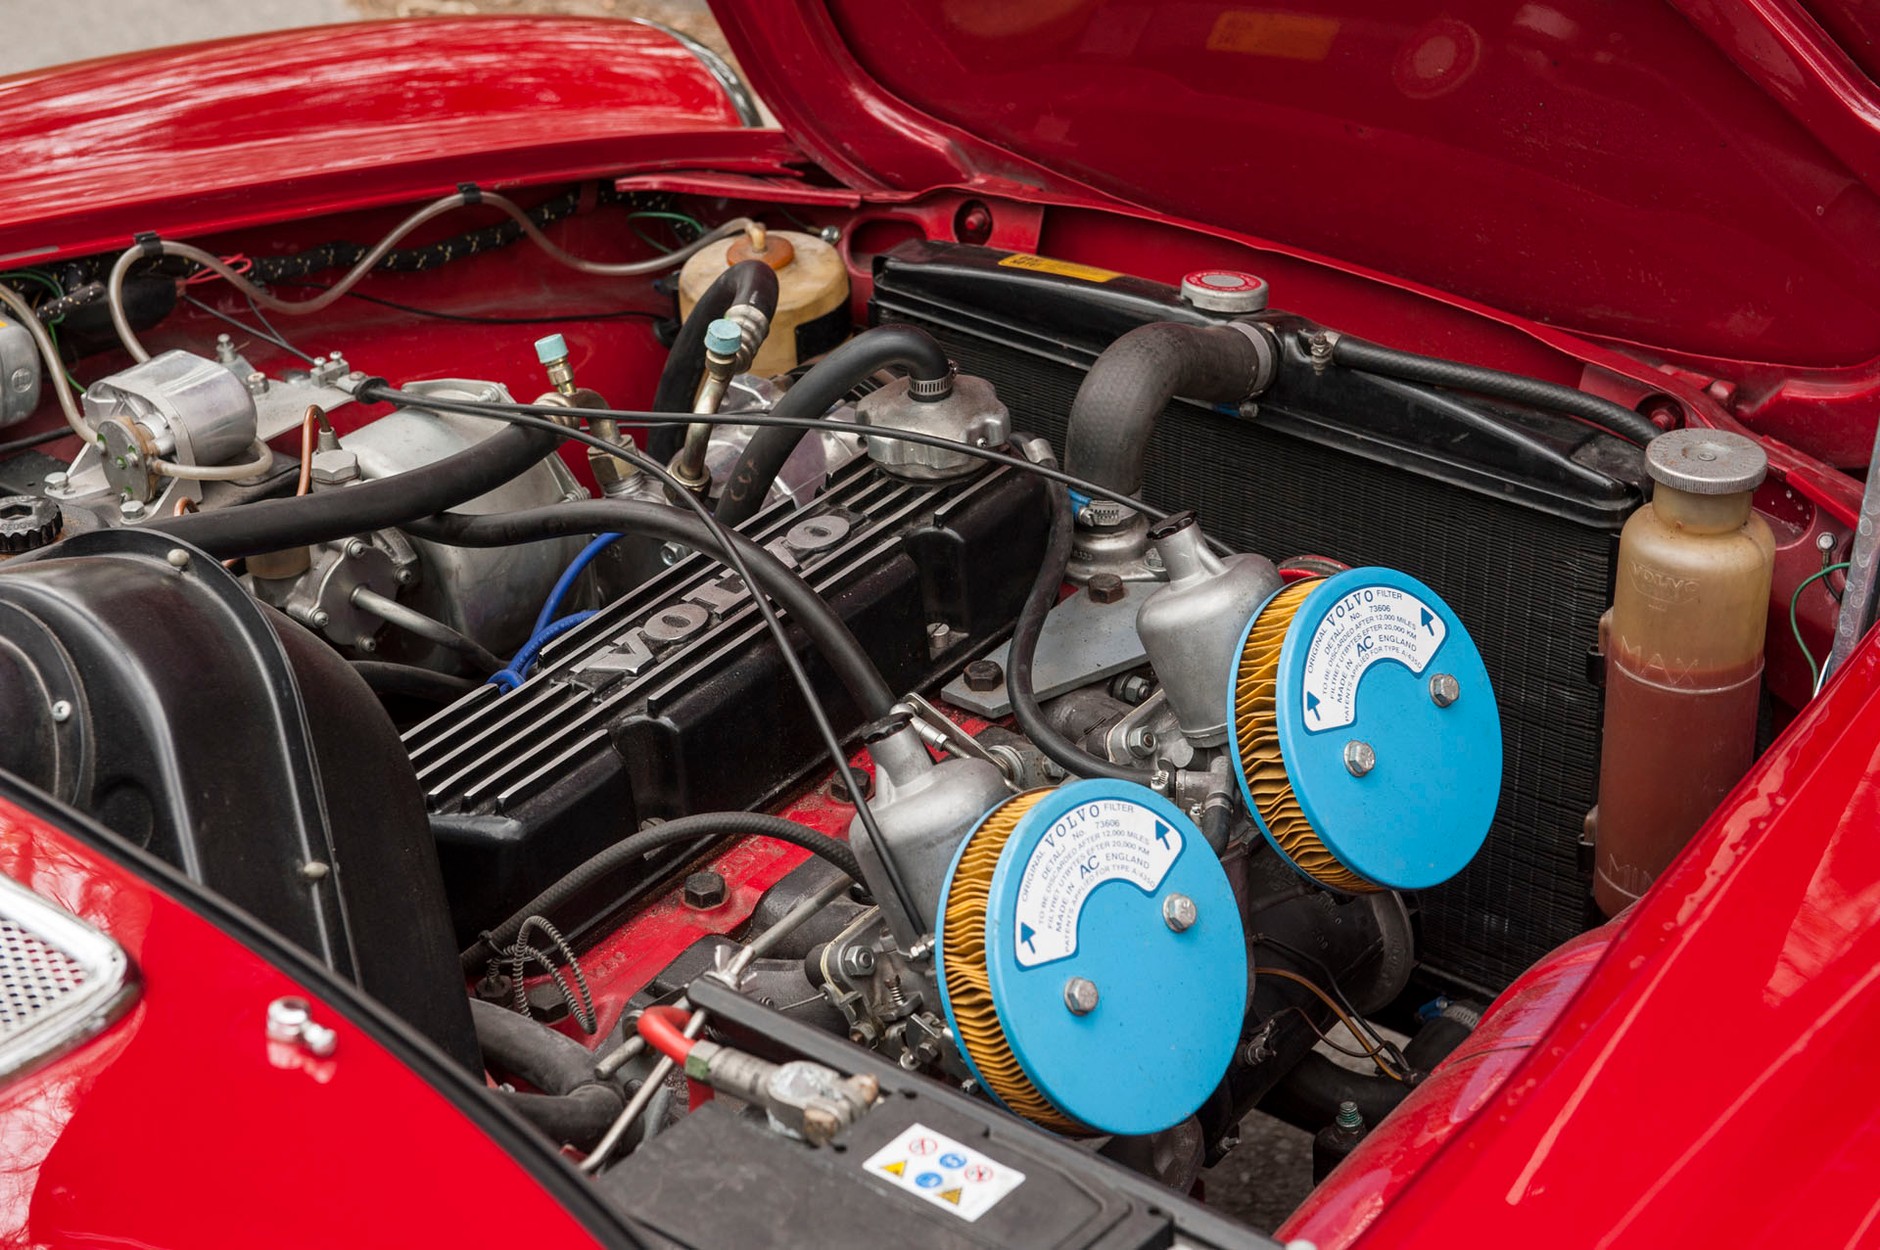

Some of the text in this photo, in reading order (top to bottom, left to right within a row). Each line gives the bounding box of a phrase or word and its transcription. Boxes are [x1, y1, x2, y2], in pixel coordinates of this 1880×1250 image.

[1631, 561, 1700, 592] VOLVO
[1307, 589, 1403, 674] ORIGINAL VOLVO FILTER
[1324, 623, 1345, 655] DETALJ
[1369, 604, 1391, 613] 73606
[1327, 627, 1355, 668] DISCARDED
[1355, 615, 1374, 630] AFTER
[1396, 616, 1416, 631] MILES
[1324, 668, 1331, 681] BE
[1330, 662, 1341, 700] FILTRET
[1338, 633, 1363, 663] UTBYTES
[1362, 624, 1383, 637] EFTER
[1406, 630, 1417, 640] KM
[1337, 634, 1417, 704] MADE IN AC ENGLAND
[1344, 681, 1353, 722] PATENTS
[1350, 653, 1370, 680] APPLIED
[1370, 645, 1383, 656] FOR
[1384, 645, 1400, 654] TYPE
[1621, 635, 1698, 685] MAX
[1322, 682, 1328, 695] TO
[1022, 803, 1134, 902] ORIGINAL VOLVO FILTER
[1042, 844, 1066, 880] DETALJ
[1095, 819, 1120, 829] 73606
[1086, 841, 1110, 856] EFTER
[1138, 846, 1150, 855] KM
[1039, 911, 1045, 924] TO
[1046, 848, 1077, 893] DISCARDED
[1078, 833, 1101, 849] AFTER
[1127, 830, 1150, 845] MILES
[1056, 852, 1150, 933] MADE IN AC ENGLAND
[1065, 907, 1074, 953] PATENTS
[1112, 864, 1130, 873] TYPE
